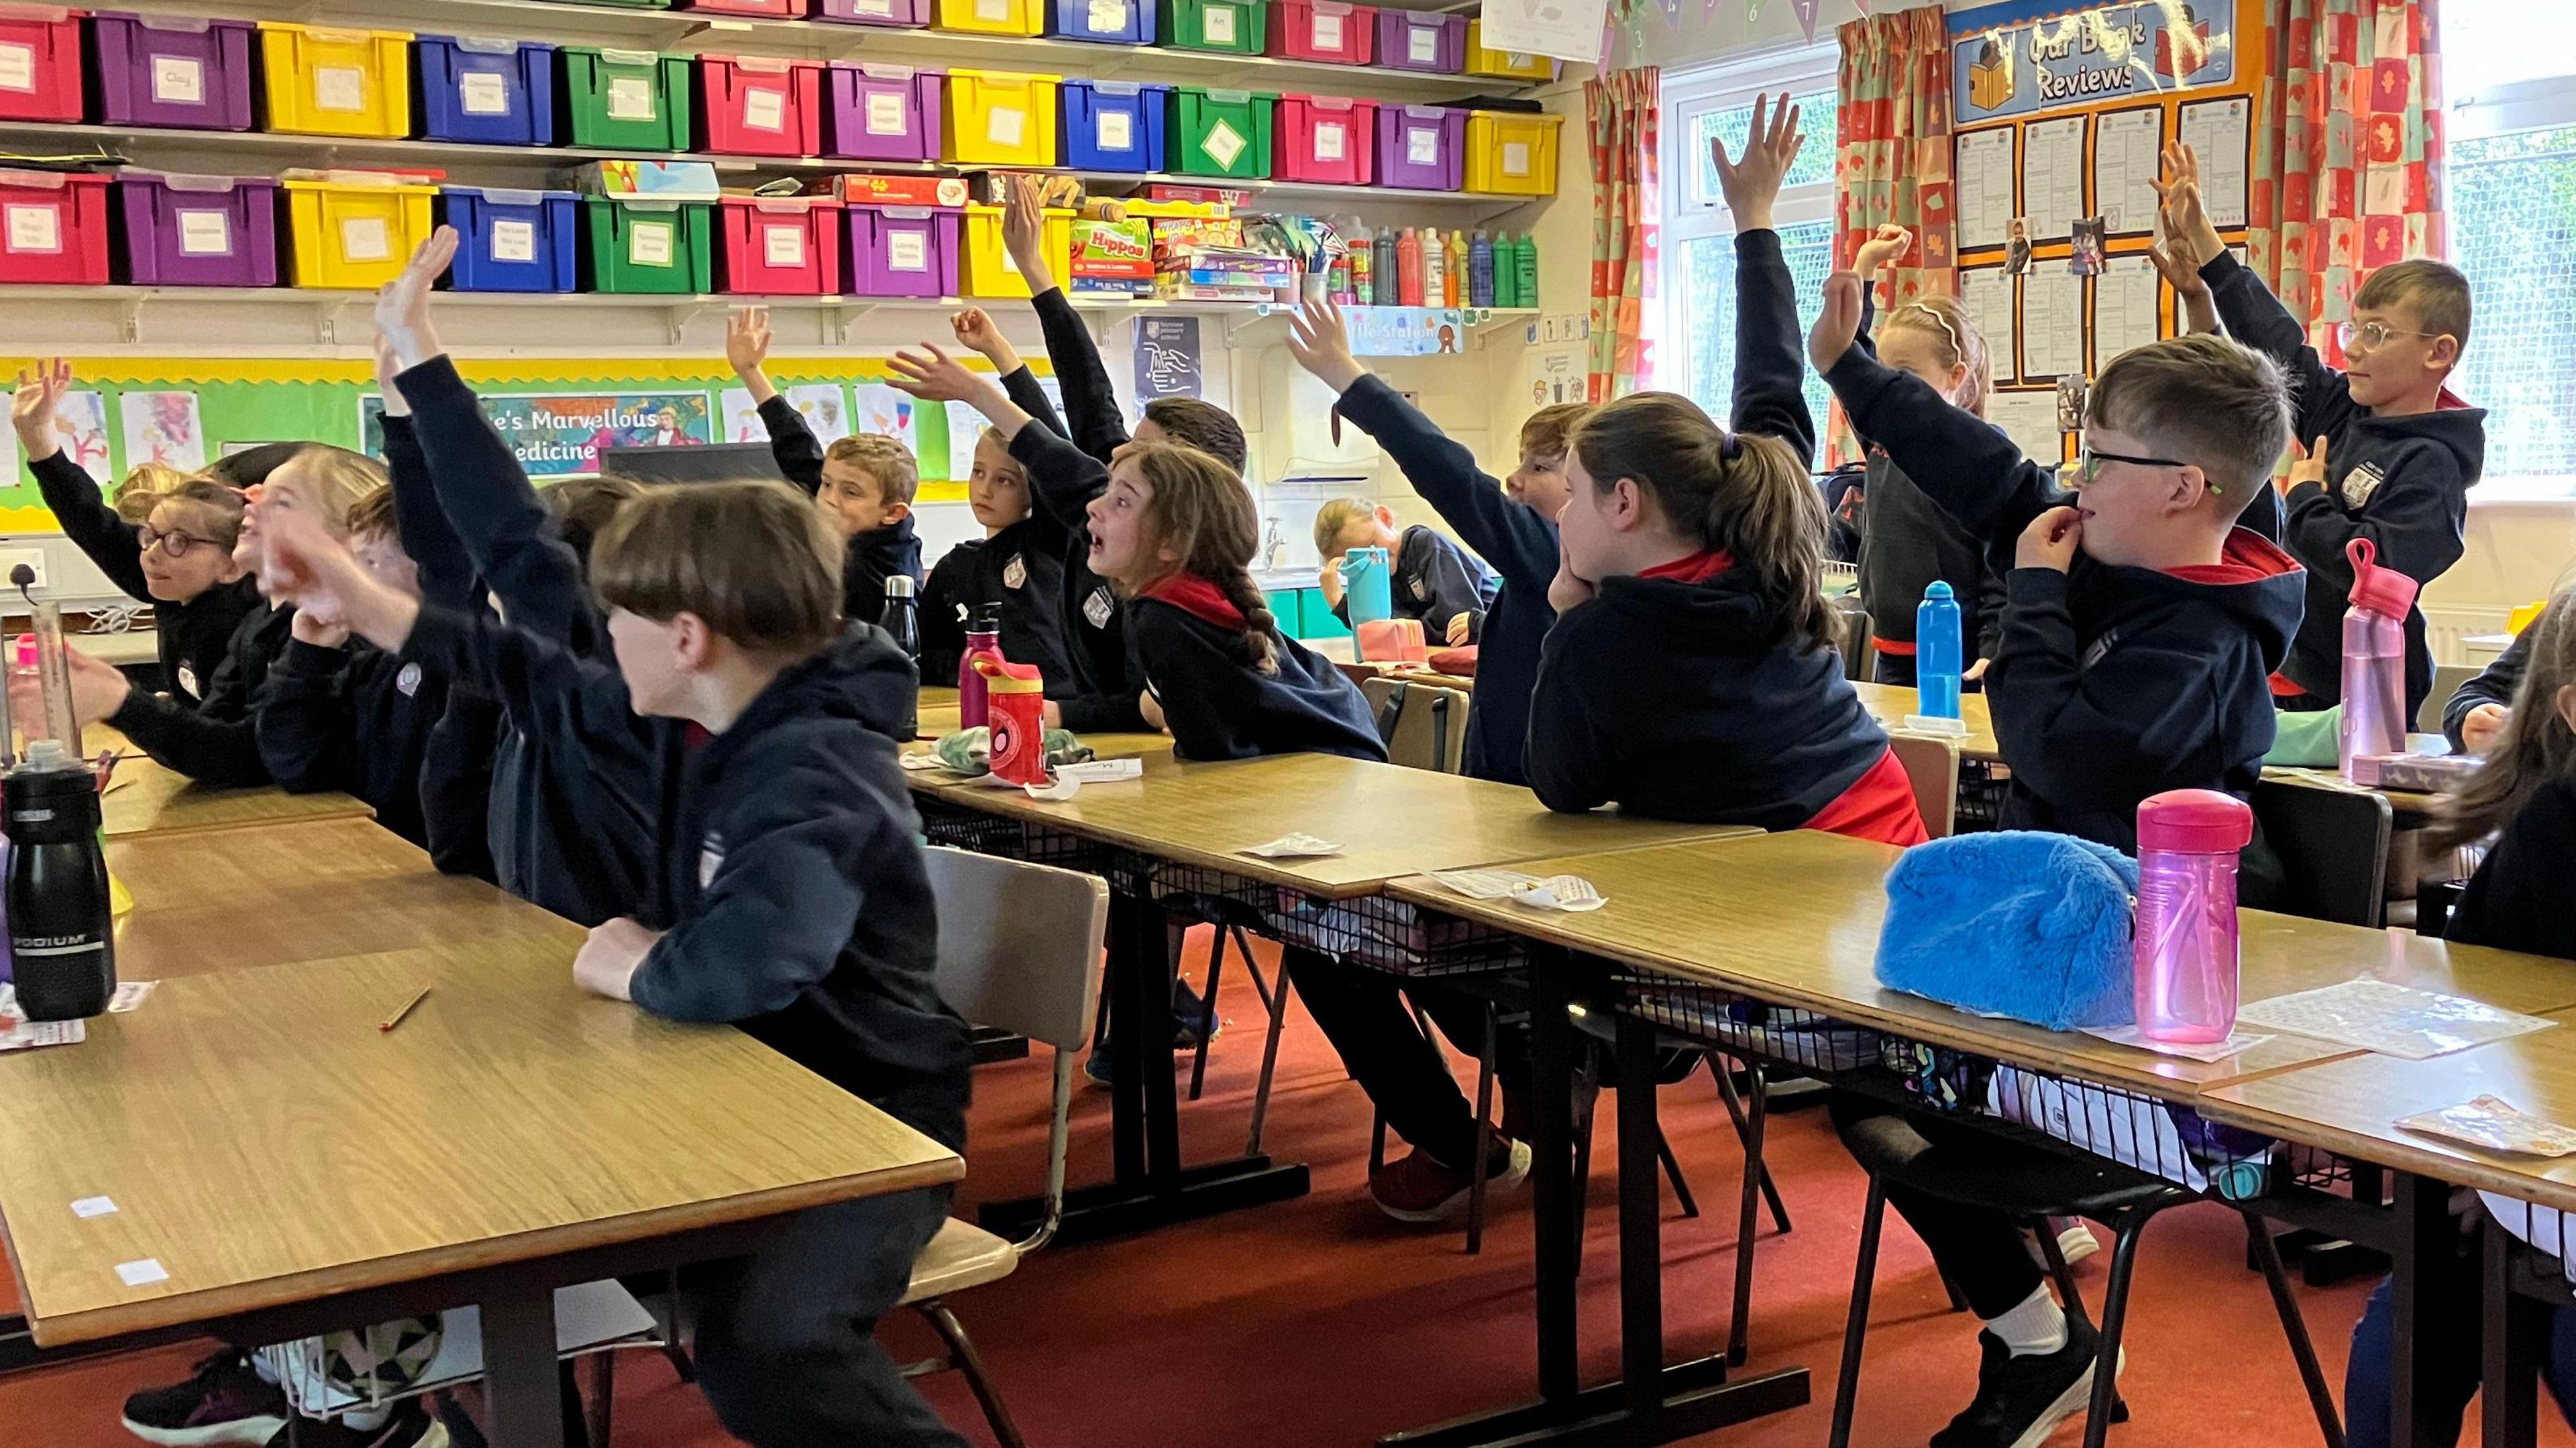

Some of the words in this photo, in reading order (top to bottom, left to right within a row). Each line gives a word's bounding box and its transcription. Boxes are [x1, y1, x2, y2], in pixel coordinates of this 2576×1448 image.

[1748, 6, 1758, 21] 6
[1800, 2, 1812, 21] 7
[1635, 31, 1643, 48] 3
[2029, 33, 2073, 64] Our
[166, 72, 192, 87] Clay
[2037, 64, 2133, 101] Reviews
[1091, 231, 1144, 258] Hippos
[489, 409, 523, 431] e's
[531, 408, 659, 430] Marvellous
[510, 440, 596, 462] edicine
